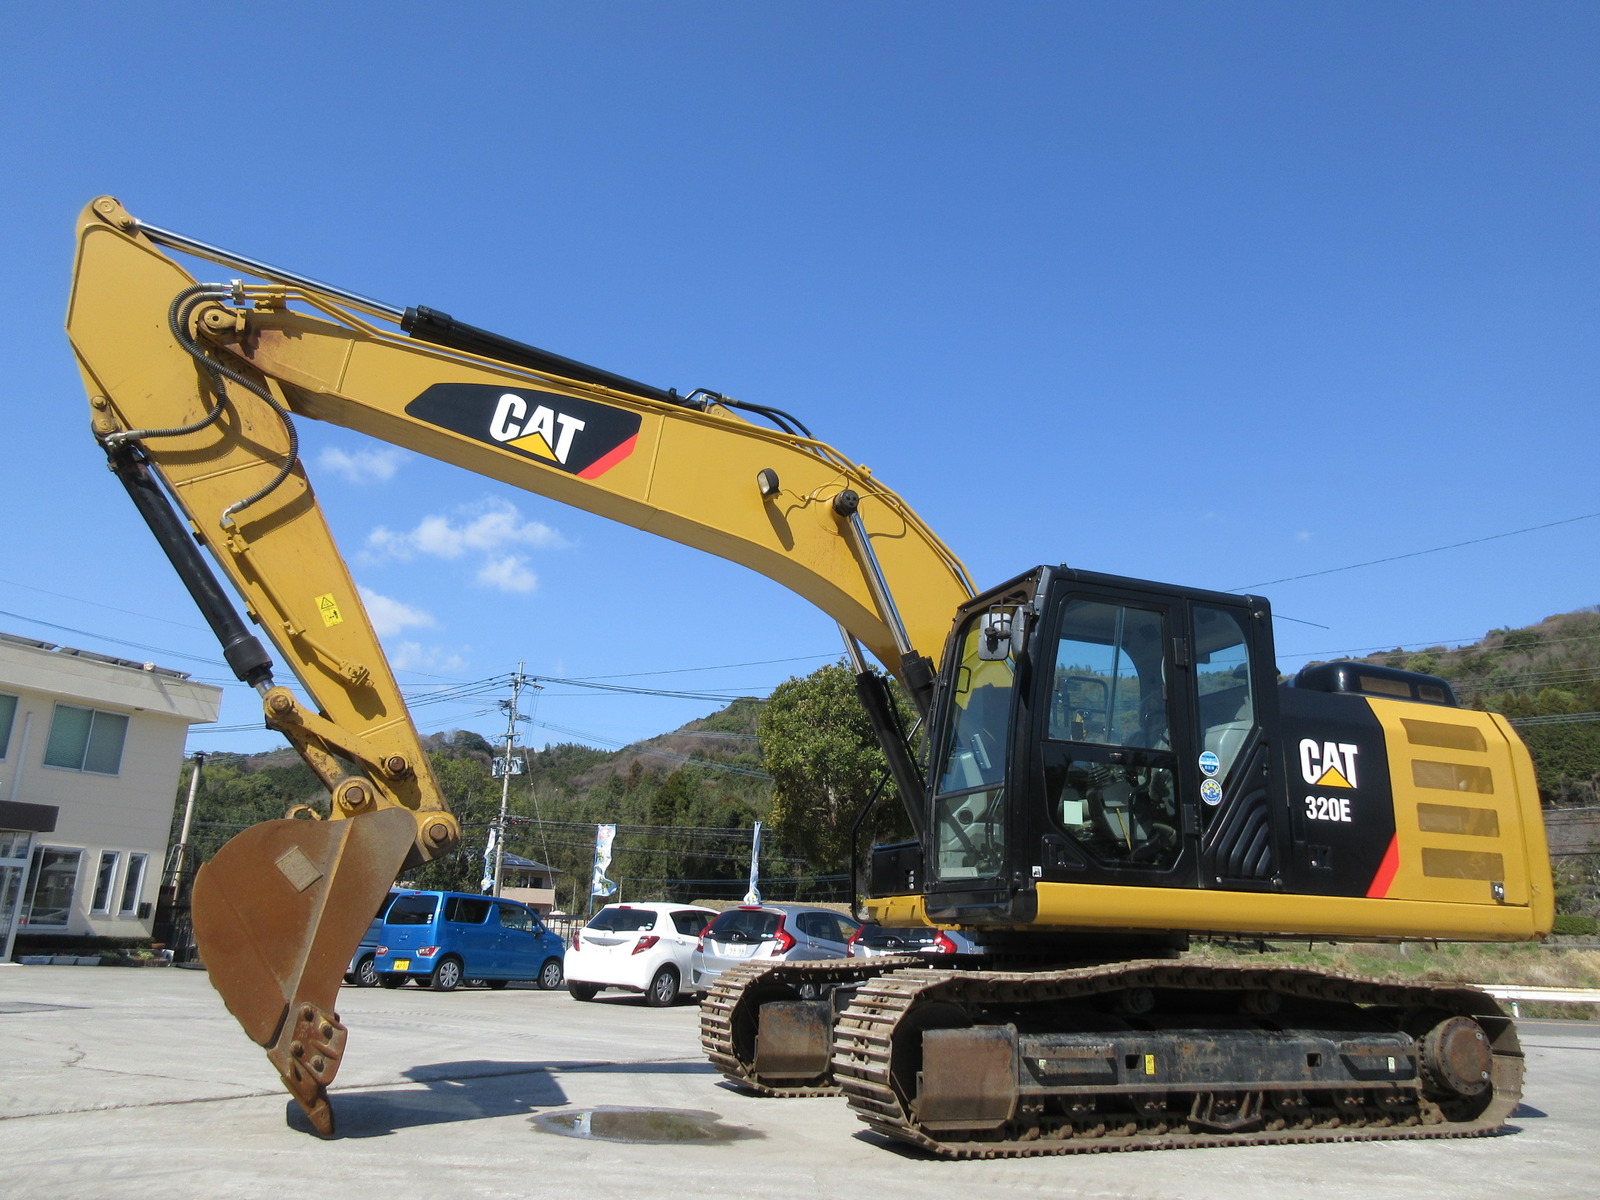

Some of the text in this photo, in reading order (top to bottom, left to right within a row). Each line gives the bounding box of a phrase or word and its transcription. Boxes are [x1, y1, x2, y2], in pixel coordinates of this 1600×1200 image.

[490, 394, 585, 464] CAT
[1300, 739, 1358, 788] CAT
[1305, 796, 1352, 822] 320E
